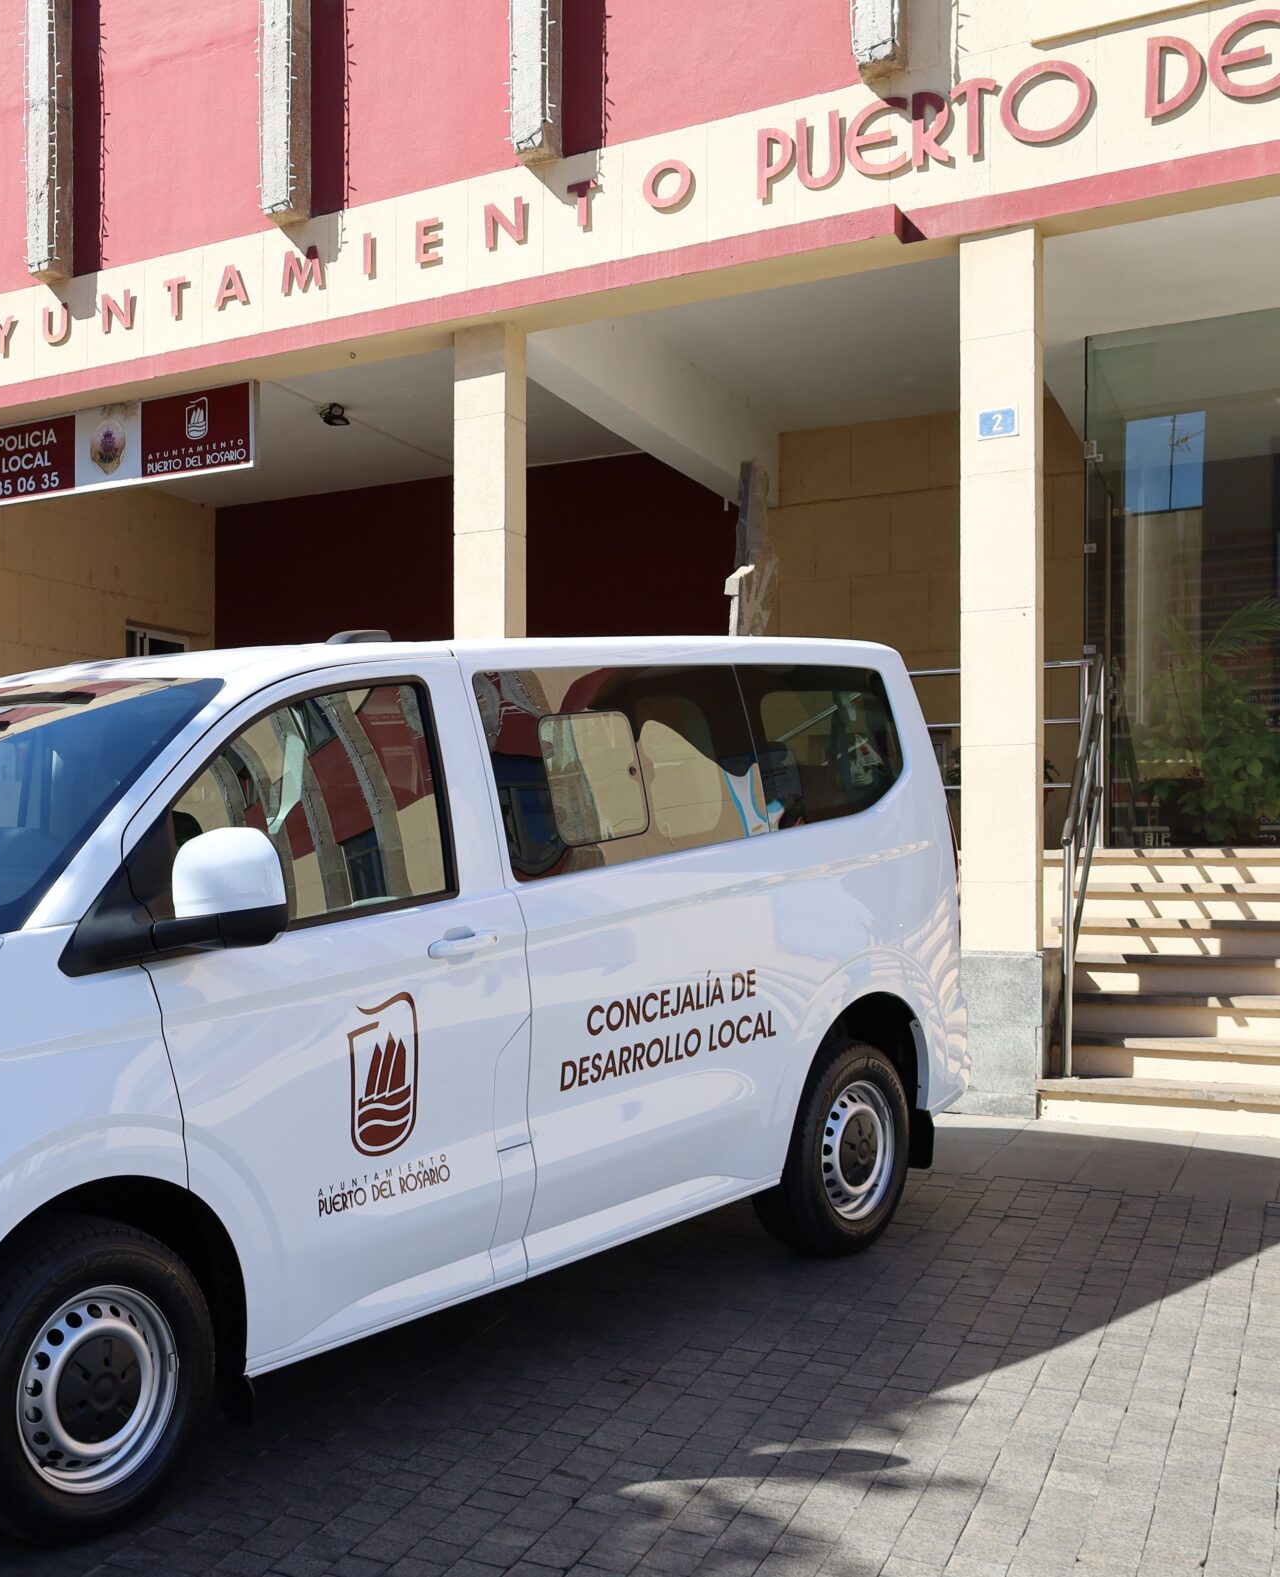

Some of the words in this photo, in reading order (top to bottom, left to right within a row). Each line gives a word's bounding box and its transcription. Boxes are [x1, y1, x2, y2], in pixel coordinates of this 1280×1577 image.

[756, 60, 1093, 202] PUERTO
[1145, 8, 1280, 119] DE
[991, 413, 1004, 431] 2
[1, 450, 52, 474] LOCAL
[147, 438, 245, 461] AYUNTAMIENTO
[147, 459, 182, 475] PUERTO
[185, 455, 203, 469] DEL
[206, 448, 247, 465] ROSARIO
[17, 474, 36, 493] 06
[41, 471, 60, 489] 35
[586, 970, 725, 1036] CONCEJALÍA
[731, 969, 756, 1002] DE
[560, 1028, 702, 1092] DESARROLLO
[708, 1010, 777, 1052] LOCAL
[317, 1153, 447, 1198] AYUNTAMIENTO
[318, 1187, 367, 1217] PUERTO
[371, 1181, 396, 1202] DEL
[399, 1164, 451, 1194] ROSARIO
